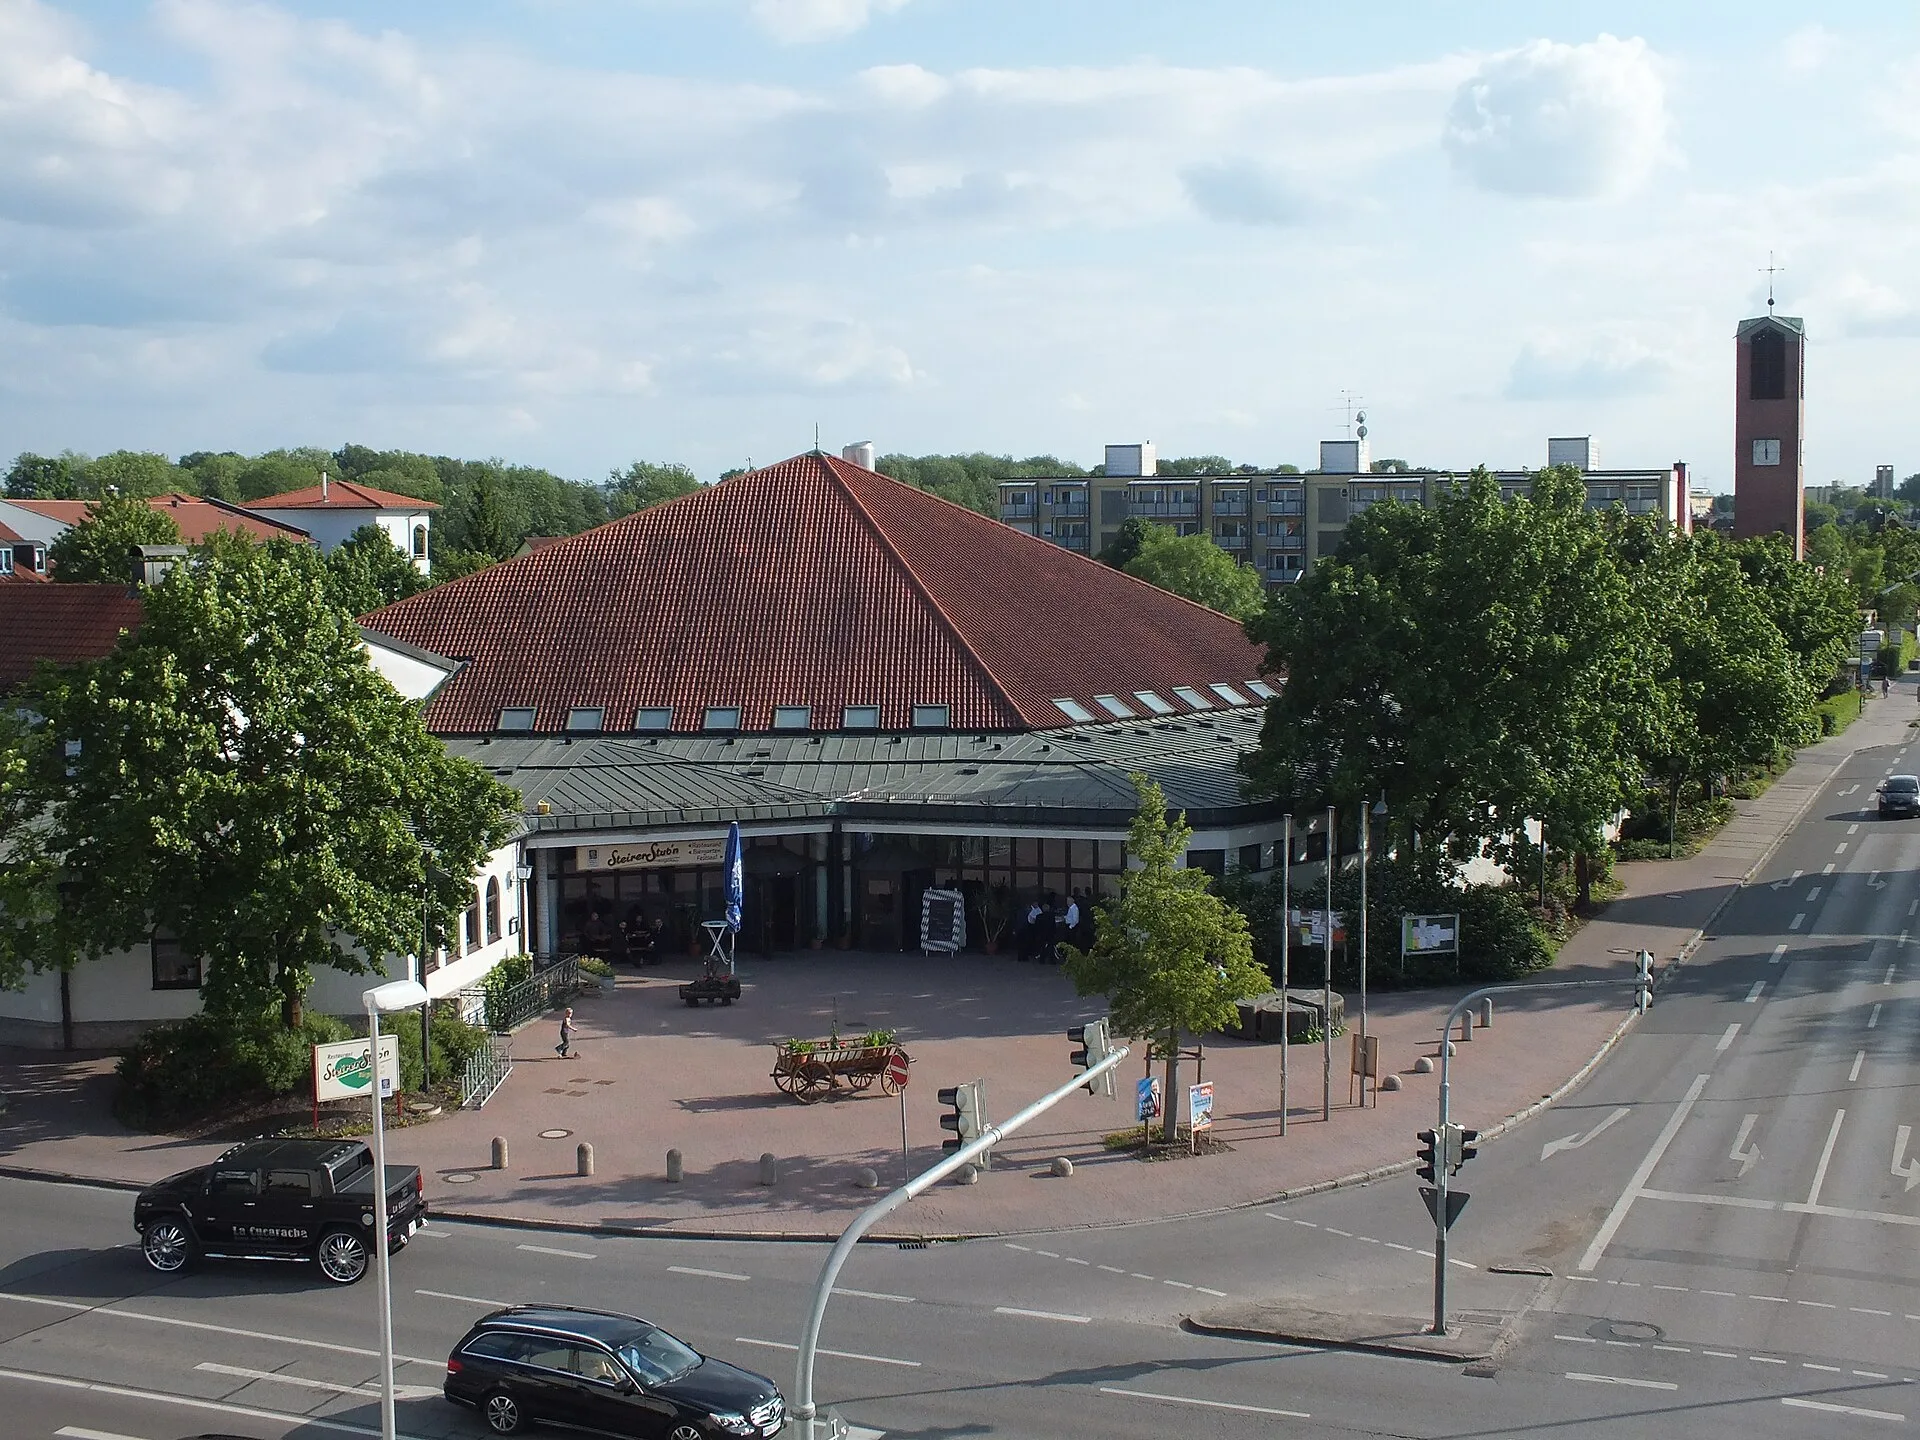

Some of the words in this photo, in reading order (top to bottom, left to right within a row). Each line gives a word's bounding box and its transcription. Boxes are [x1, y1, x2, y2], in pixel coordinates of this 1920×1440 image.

[327, 1051, 354, 1060] Restaurant
[232, 1226, 246, 1236] La
[249, 1226, 308, 1238] Cucaracha
